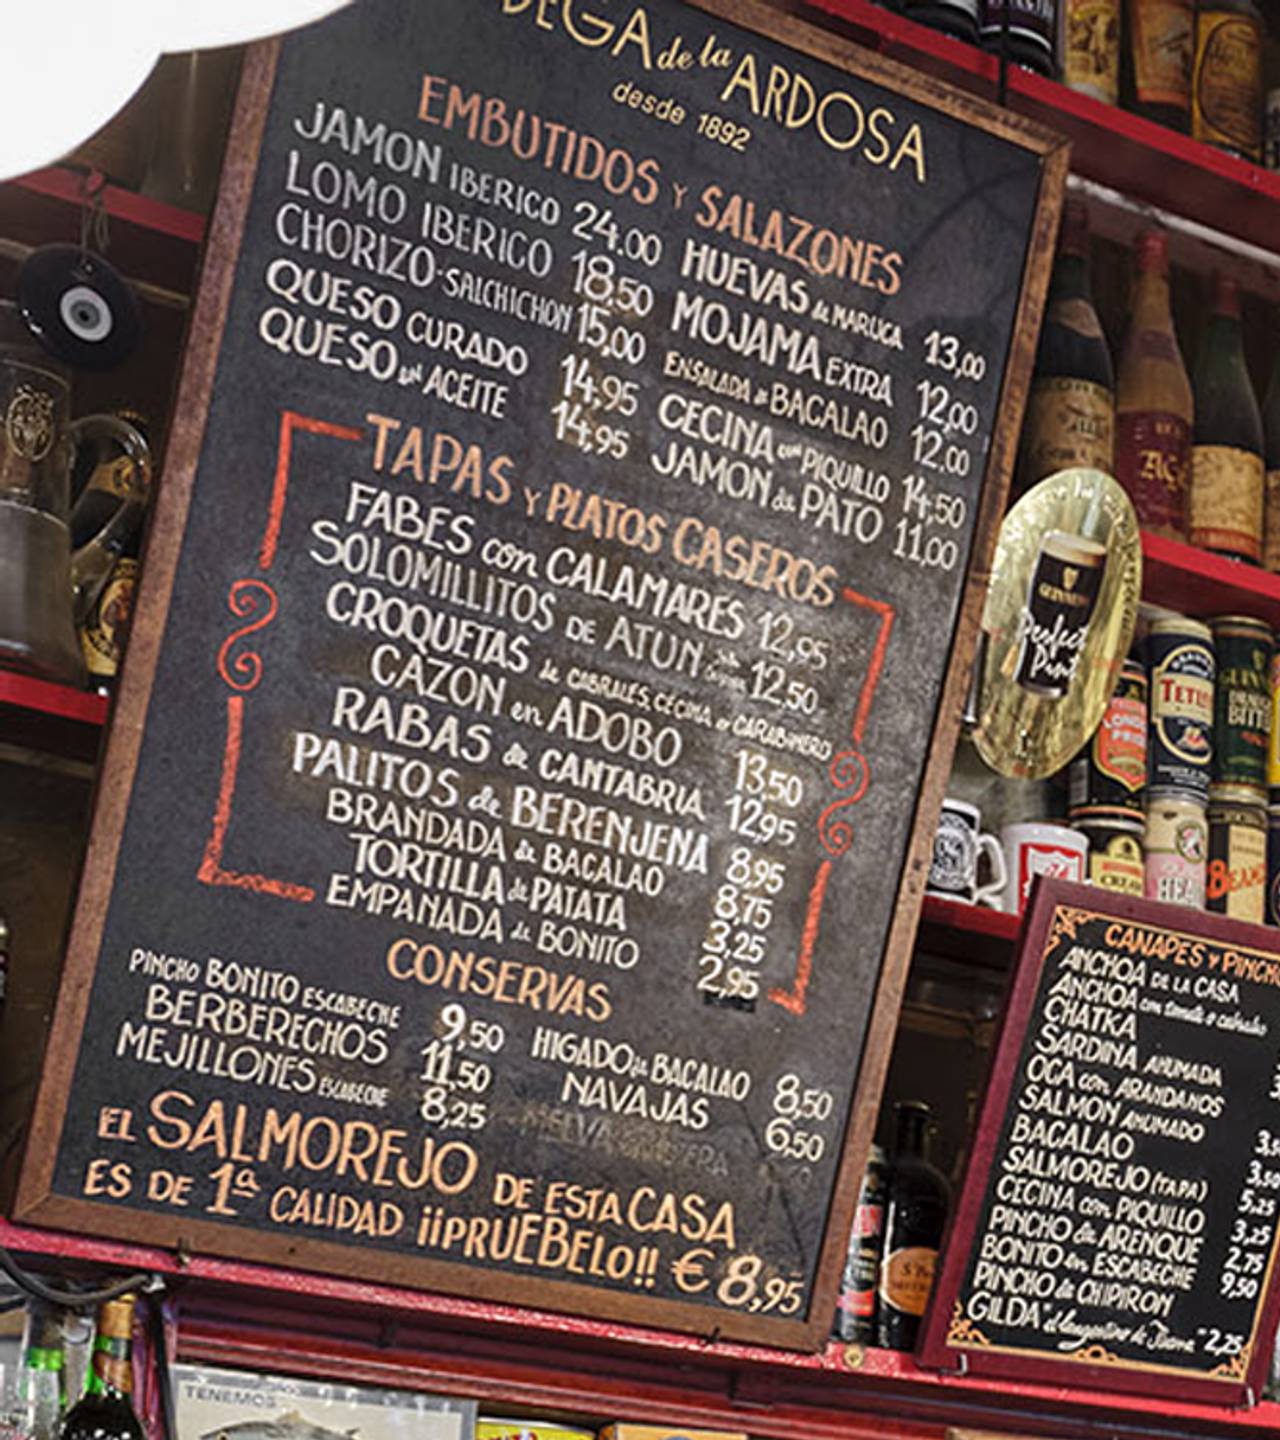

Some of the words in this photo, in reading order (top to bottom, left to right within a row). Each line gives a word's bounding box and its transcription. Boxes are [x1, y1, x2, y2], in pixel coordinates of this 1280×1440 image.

[294, 102, 444, 183] JAMON
[449, 163, 561, 226] IBERICO
[612, 80, 687, 125] desde
[696, 113, 752, 153] 1892
[721, 53, 926, 182] ARDOSA
[286, 149, 407, 225] LOMO
[421, 202, 554, 277] IBERICO
[416, 73, 662, 205] EMBUTIDOS
[695, 185, 904, 296] SALAZONES
[266, 257, 402, 330] QUESO
[405, 311, 529, 376] CURADO
[561, 354, 639, 416] 14,95
[577, 303, 645, 365] 15,00
[671, 291, 822, 381] MOJAMA
[825, 357, 894, 408] EXTRA
[681, 239, 809, 315] HUEVAS
[923, 330, 985, 381] 13,00
[258, 306, 399, 382] QUESO
[422, 364, 509, 419] ACEITE
[550, 399, 631, 461] 14,95
[663, 350, 751, 404] ENSALADA
[770, 381, 889, 449] BACALAO
[650, 442, 772, 509] JAMON
[800, 484, 884, 545] PATO
[657, 392, 776, 465] CECINA
[802, 447, 891, 503] PIQUILLO
[365, 412, 516, 505] TAPAS
[545, 482, 668, 555] PLATOS
[672, 516, 839, 608] CASEROS
[309, 519, 557, 634] SOLOMILLITOS
[565, 615, 597, 645] DE
[604, 615, 705, 679] ATUN
[345, 481, 477, 556] FABES
[481, 536, 538, 580] con
[546, 546, 746, 642] CALAMARES
[325, 580, 531, 673] CROQUETAS
[332, 686, 493, 765] RABAS
[538, 748, 706, 821] CANTABRIA
[370, 642, 506, 716] CAZON
[510, 701, 544, 727] en
[546, 696, 682, 768] ADOBO
[292, 731, 460, 808] PALITOS
[510, 785, 709, 875] BERENJENA
[326, 788, 506, 863] BRANDADA
[543, 842, 664, 897] BACALAO
[326, 873, 503, 943] EMPANADA
[536, 919, 641, 970] BONITO
[696, 954, 761, 1000] 2,95
[349, 832, 505, 906] TORTILLA
[529, 876, 627, 932] PATATA
[701, 921, 766, 964] 3,25
[1104, 923, 1205, 969] CANAPES
[128, 948, 200, 985] PINCHO
[204, 956, 300, 1005] BONITO
[302, 986, 401, 1029] ESCABECHE
[440, 1003, 505, 1054] 9,50
[145, 983, 389, 1065] BERBERECHOS
[387, 937, 613, 1022] CONSERVAS
[1043, 996, 1137, 1040] CHATKA
[1048, 972, 1139, 1012] ANCHOA
[1058, 946, 1147, 987] ANCHOA
[1193, 976, 1240, 1004] CASA
[116, 1021, 317, 1094] MEJILLONES
[420, 1087, 487, 1131] 8,25
[532, 1026, 635, 1076] HIGADO
[650, 1053, 751, 1101] BACALAO
[561, 1070, 710, 1131] NAVAJAS
[1026, 1055, 1075, 1090] OCA
[1077, 1073, 1111, 1096] con
[1114, 1077, 1226, 1119] ARANDANOS
[1035, 1024, 1138, 1072] SARDINA
[1144, 1056, 1223, 1088] AHUMADA
[1010, 1113, 1135, 1160] BACALAO
[1019, 1083, 1121, 1126] SALMON
[1120, 1111, 1205, 1143] AHUMADO
[83, 1159, 132, 1198] ES
[148, 1170, 193, 1207] DE
[269, 1186, 404, 1237] CALIDAD
[98, 1107, 136, 1142] EL
[147, 1090, 479, 1195] SALMOREJO
[493, 1172, 533, 1210] DE
[544, 1182, 623, 1227] ESTA
[627, 1186, 737, 1251] CASA
[996, 1175, 1076, 1212] CECINA
[1115, 1197, 1205, 1236] PIQUILLO
[1001, 1146, 1150, 1193] SALMOREJO
[1150, 1171, 1208, 1202] (TAPA)
[981, 1234, 1063, 1270] BONITO
[1092, 1253, 1197, 1291] ESCABECHE
[989, 1205, 1073, 1242] PINCHO
[1097, 1224, 1204, 1265] ARENQUE
[967, 1290, 1041, 1331] GILDA
[973, 1261, 1057, 1298] PINCHO
[1077, 1280, 1175, 1318] CHIPIRON
